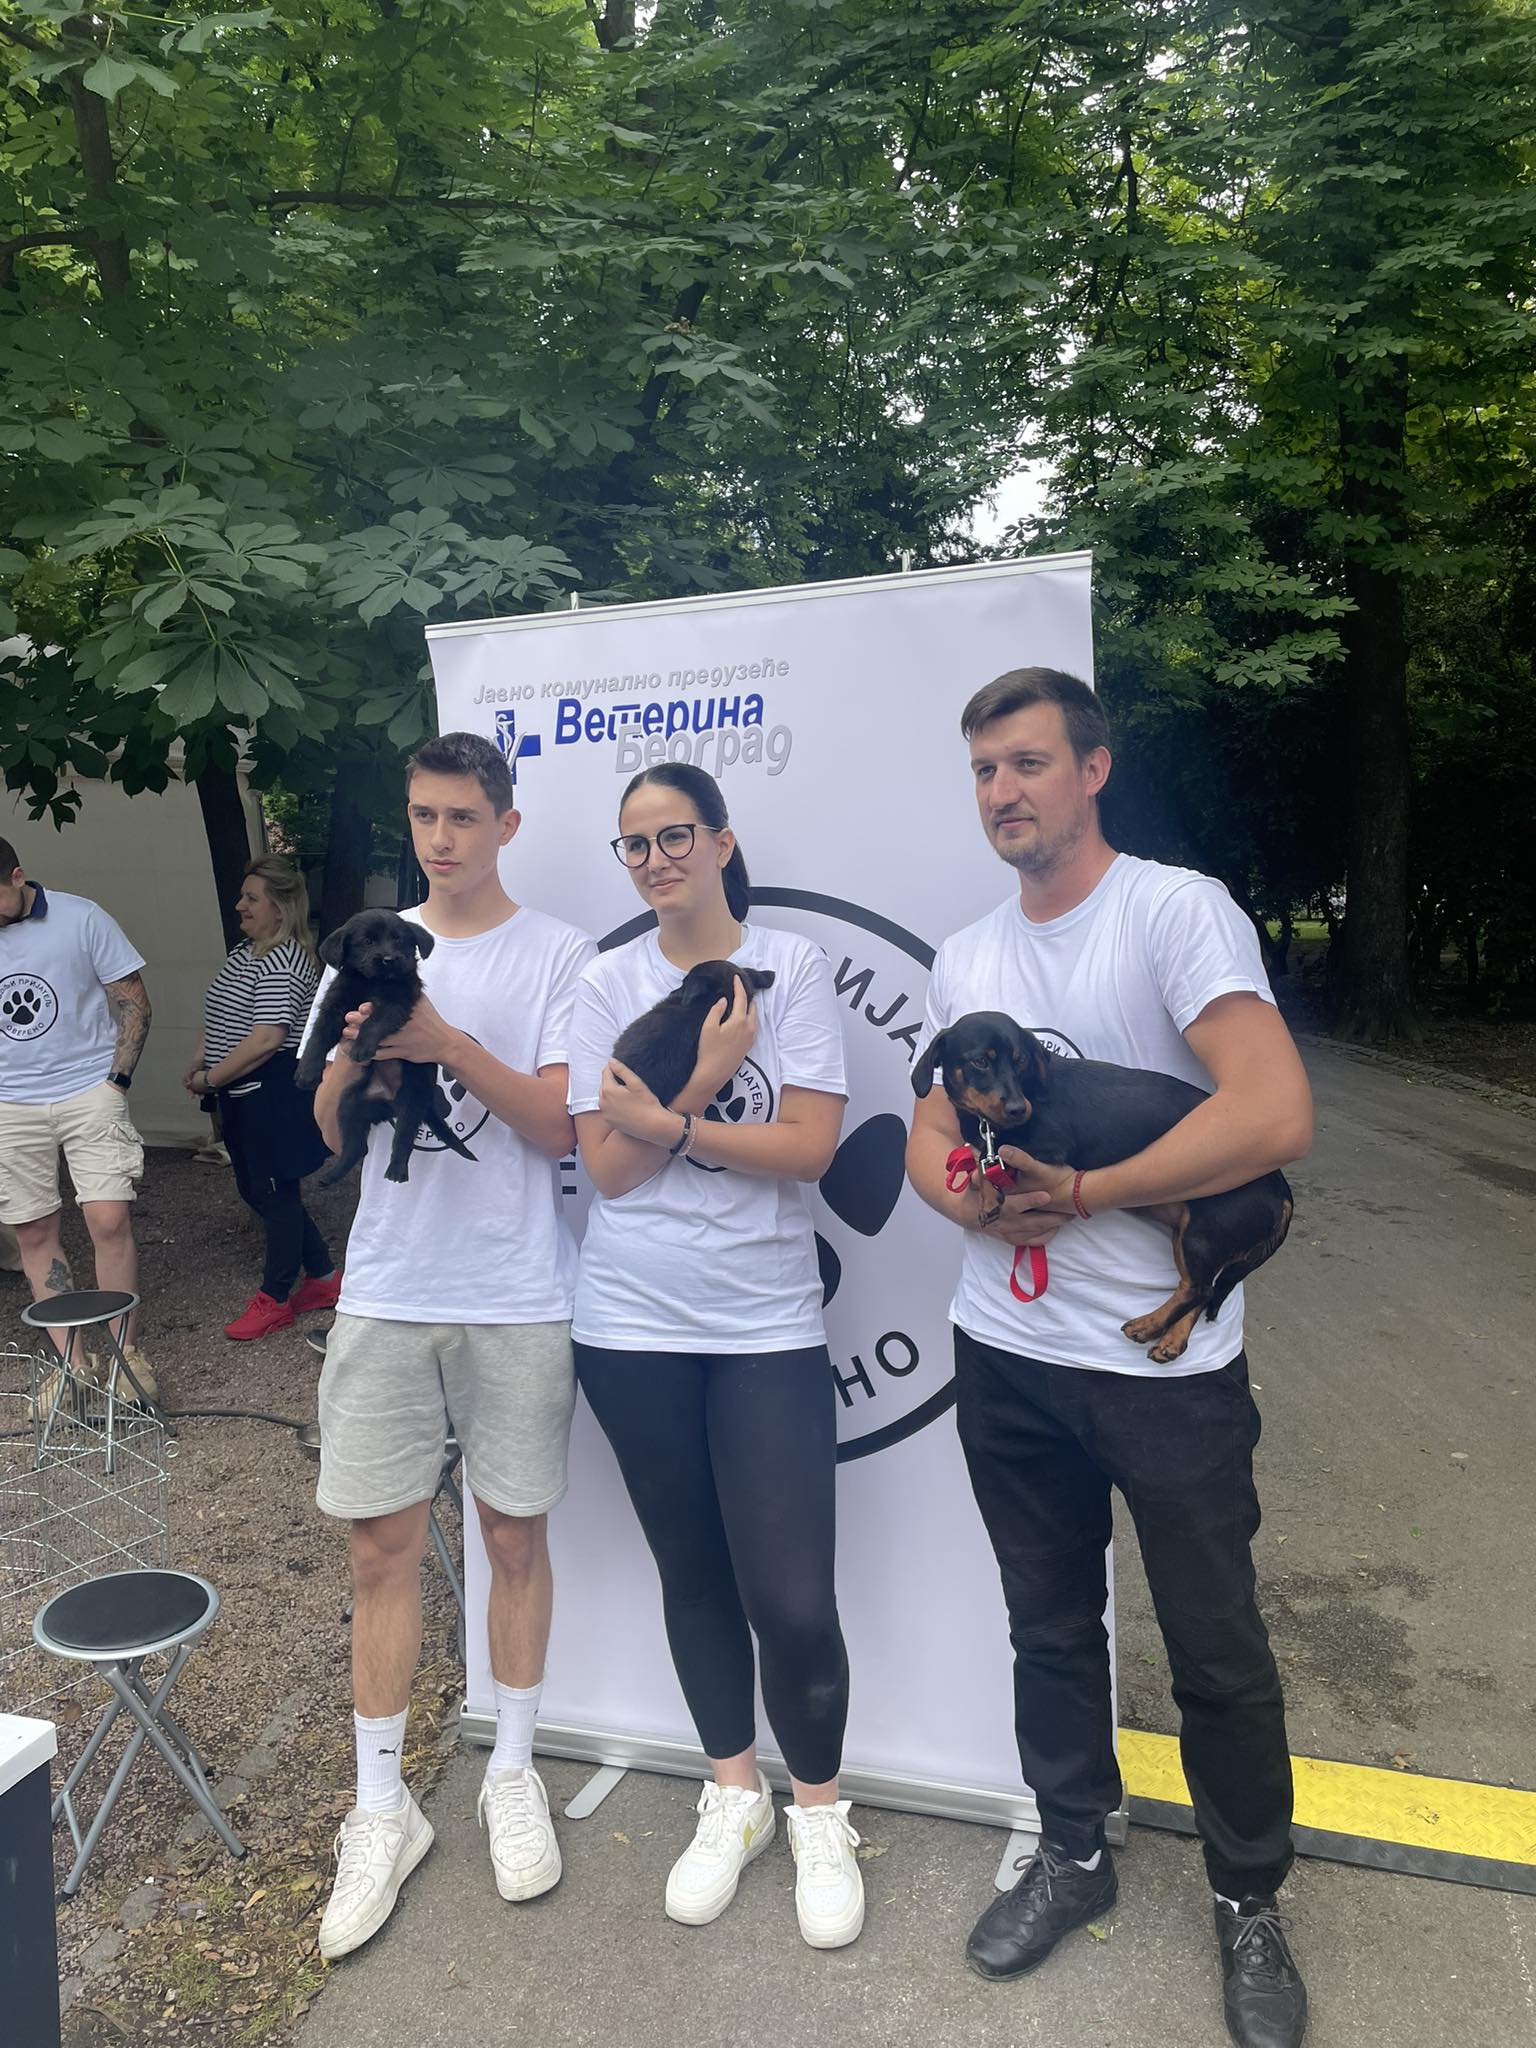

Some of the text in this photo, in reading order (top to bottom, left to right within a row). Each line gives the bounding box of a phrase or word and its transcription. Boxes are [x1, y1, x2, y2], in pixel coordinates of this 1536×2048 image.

[473, 684, 535, 705] Јавно
[540, 672, 662, 700] комунално
[555, 693, 764, 745] Ветерина
